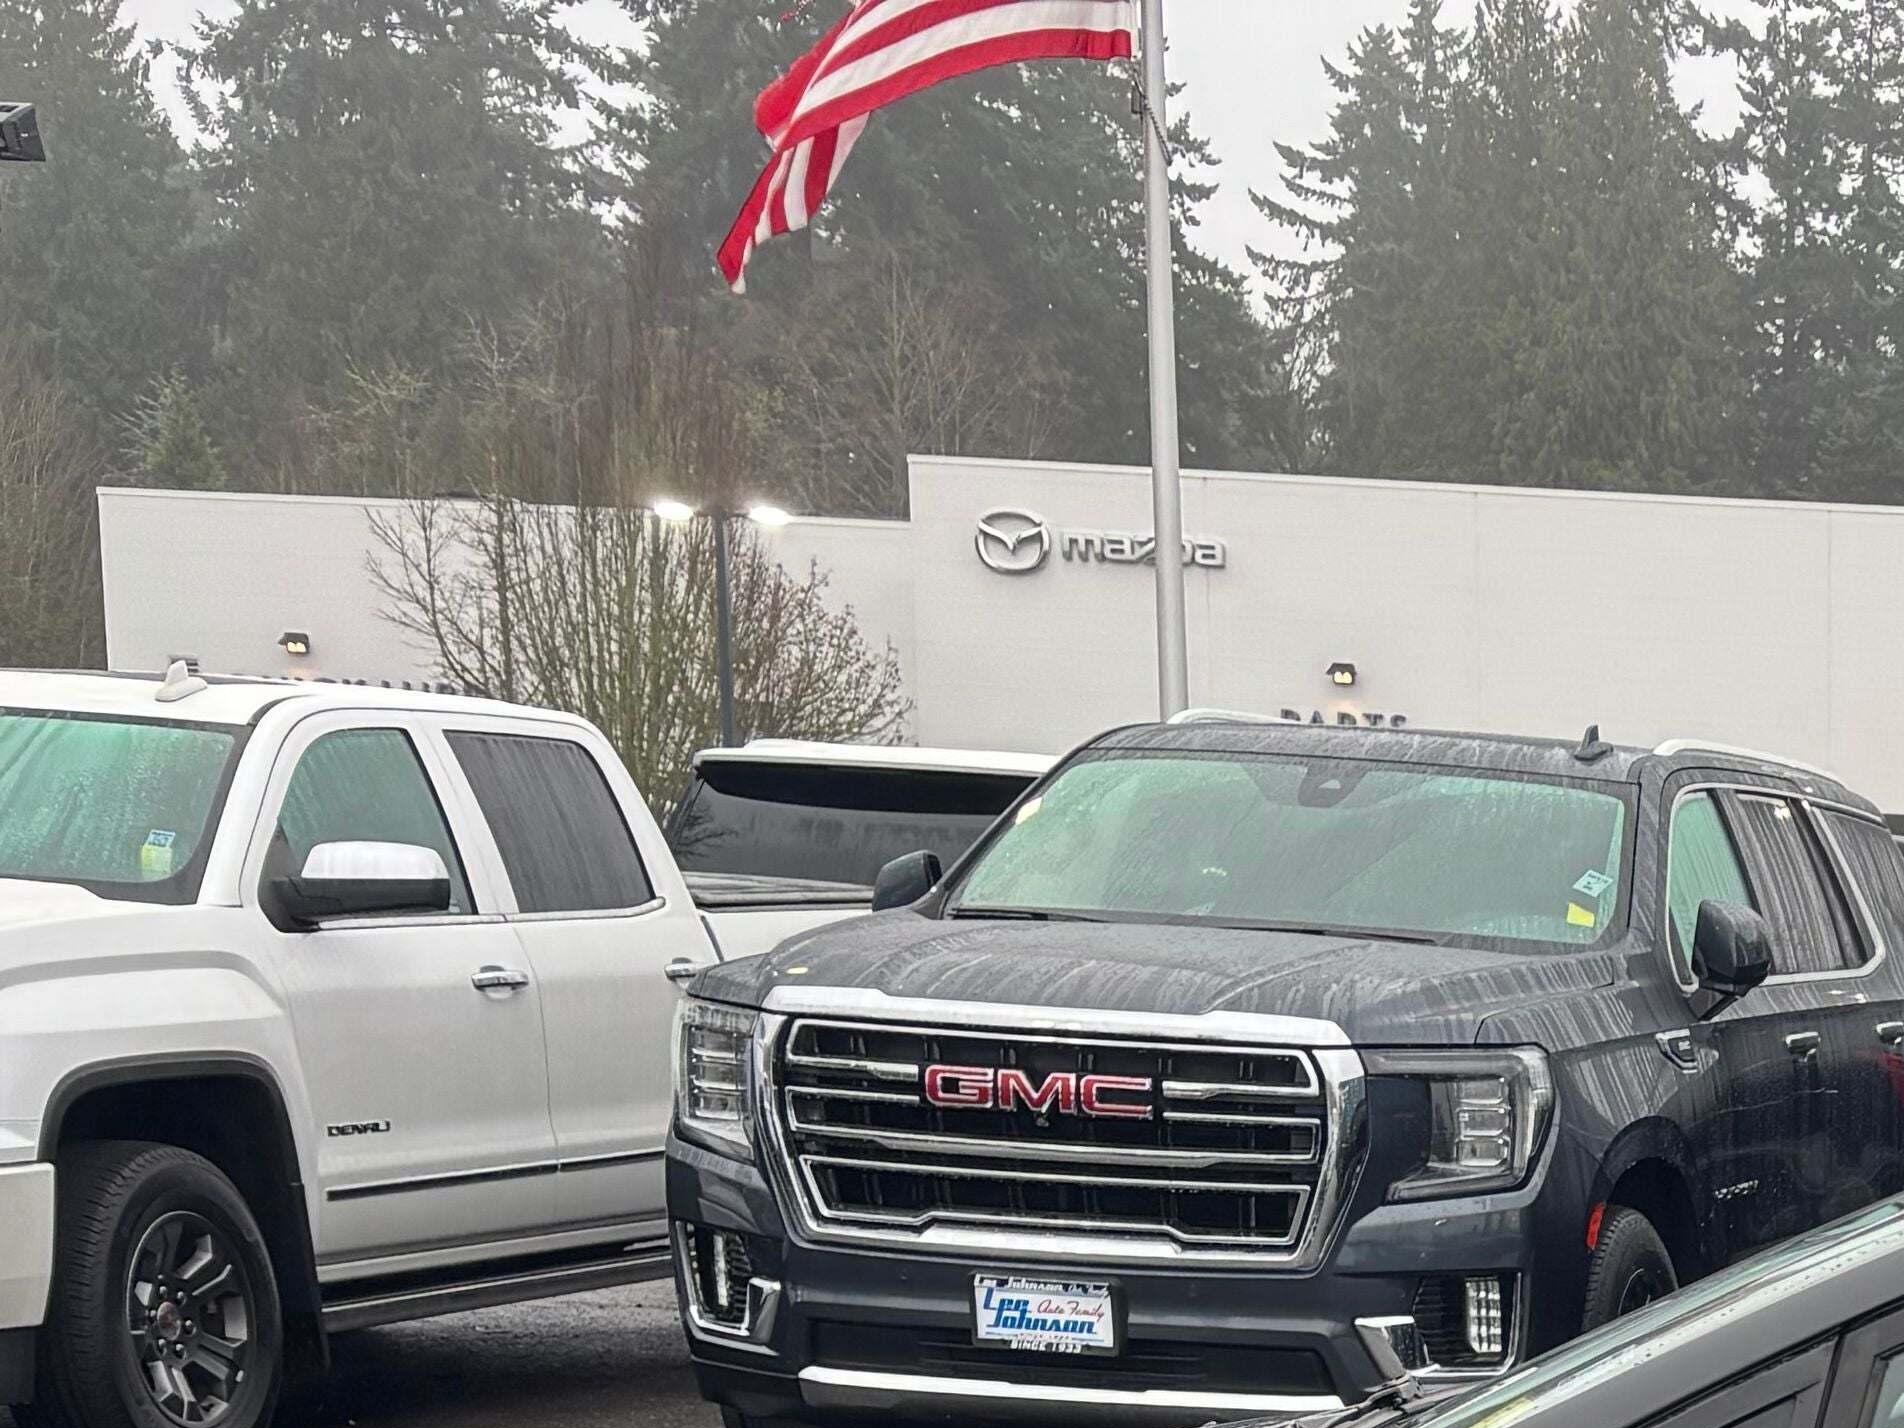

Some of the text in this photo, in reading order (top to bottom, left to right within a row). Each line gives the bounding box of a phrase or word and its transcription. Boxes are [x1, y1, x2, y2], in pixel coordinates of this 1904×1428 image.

[925, 1063, 1154, 1121] GMC
[983, 1286, 1105, 1323] Lee Auto Family
[985, 1303, 1099, 1336] Johnson
